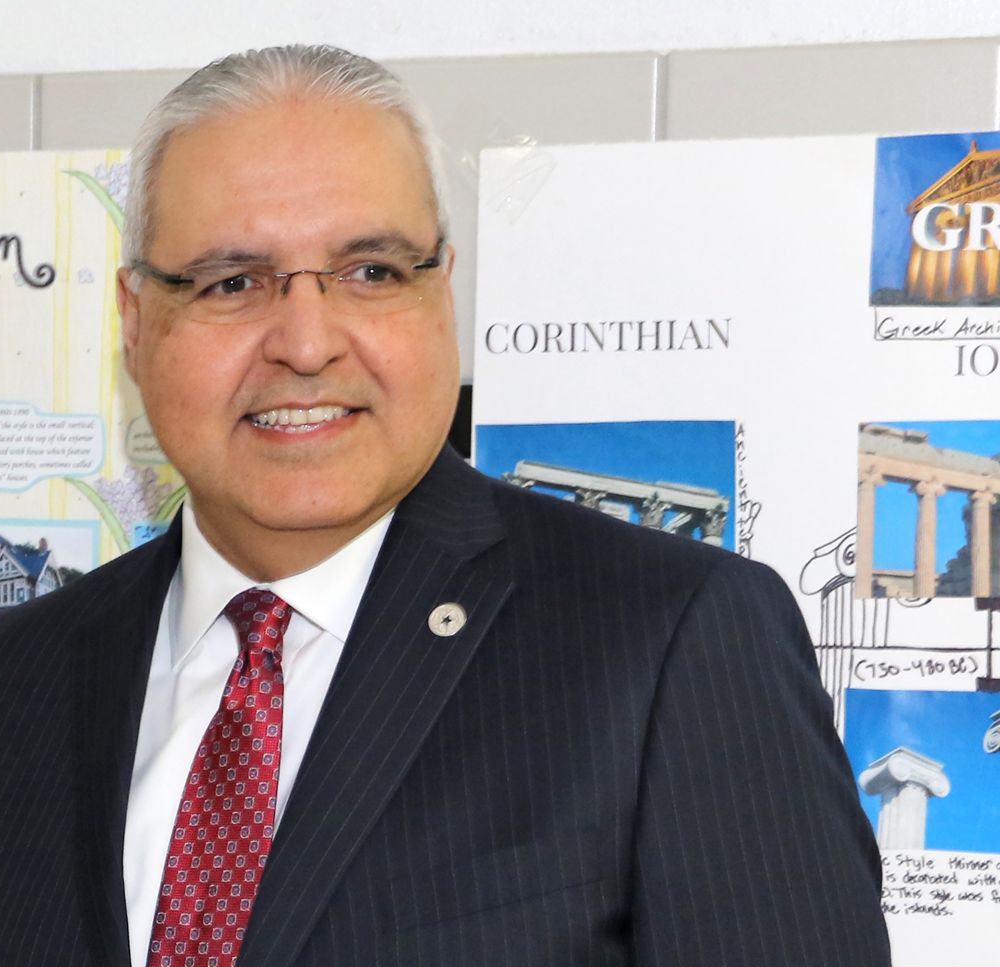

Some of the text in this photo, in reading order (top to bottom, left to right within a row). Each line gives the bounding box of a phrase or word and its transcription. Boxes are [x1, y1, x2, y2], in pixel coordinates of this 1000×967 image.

[484, 318, 733, 355] CORINTHIAN
[878, 316, 948, 340] Greek
[896, 854, 934, 871] Style
